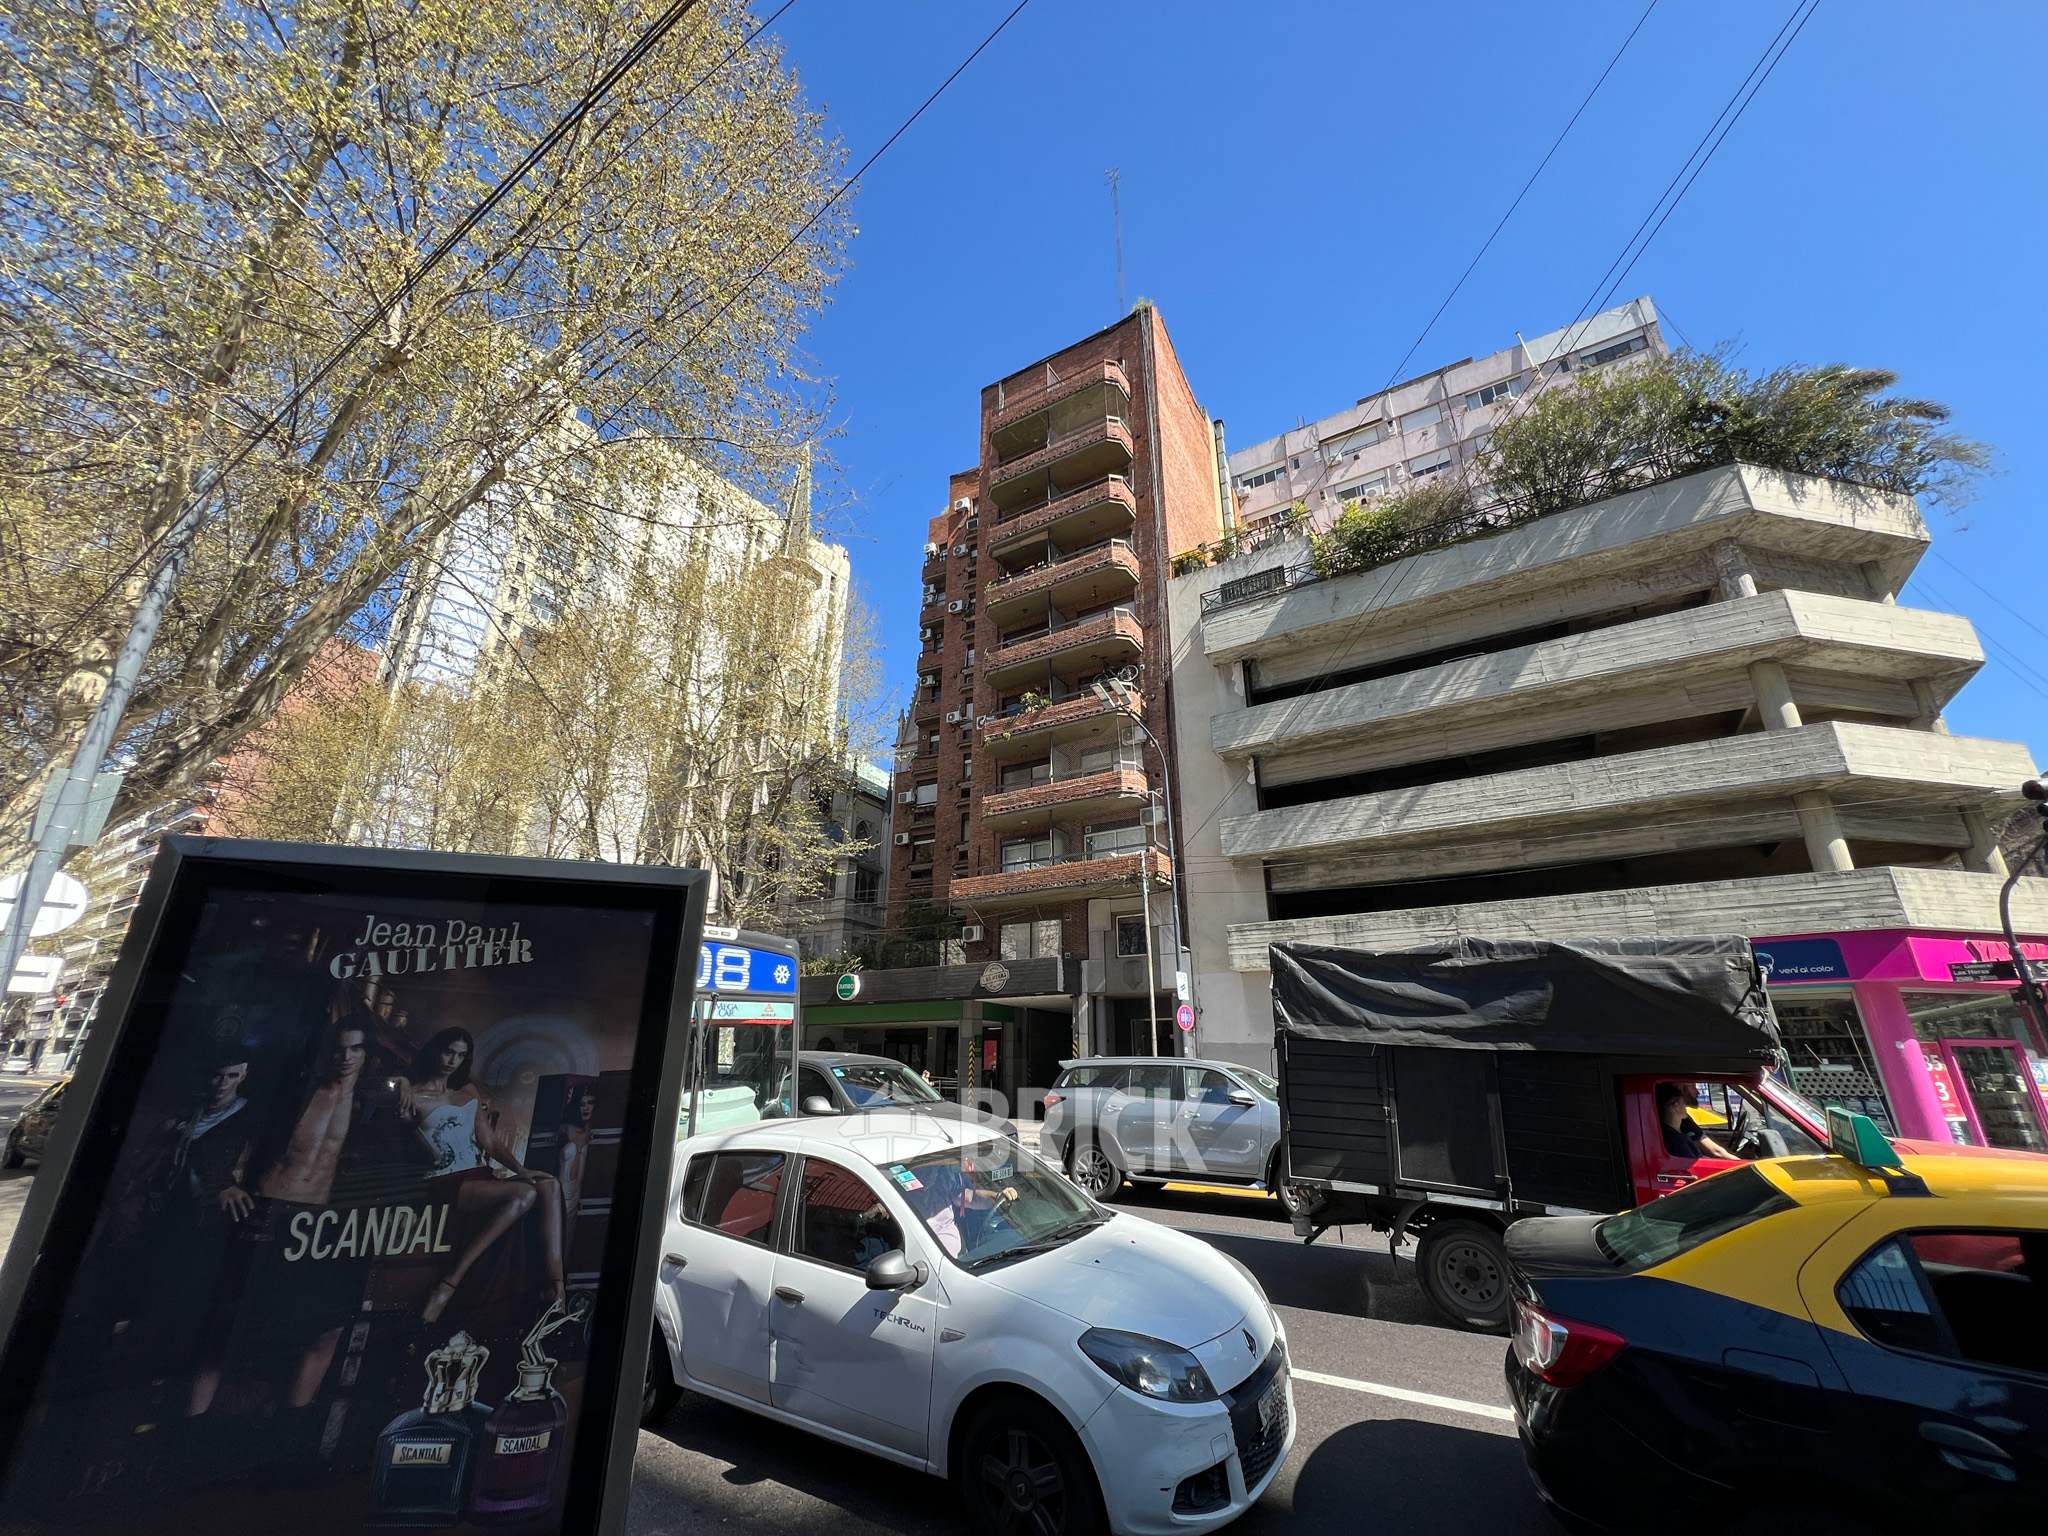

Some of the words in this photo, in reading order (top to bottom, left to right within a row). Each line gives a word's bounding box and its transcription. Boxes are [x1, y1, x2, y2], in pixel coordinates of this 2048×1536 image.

[355, 915, 437, 948] Jean
[443, 919, 521, 950] Paul
[329, 939, 534, 980] GAULTIER
[284, 1204, 452, 1261] SCANDAL
[400, 1446, 443, 1462] SCANDAL
[503, 1437, 542, 1453] SCANDAL
